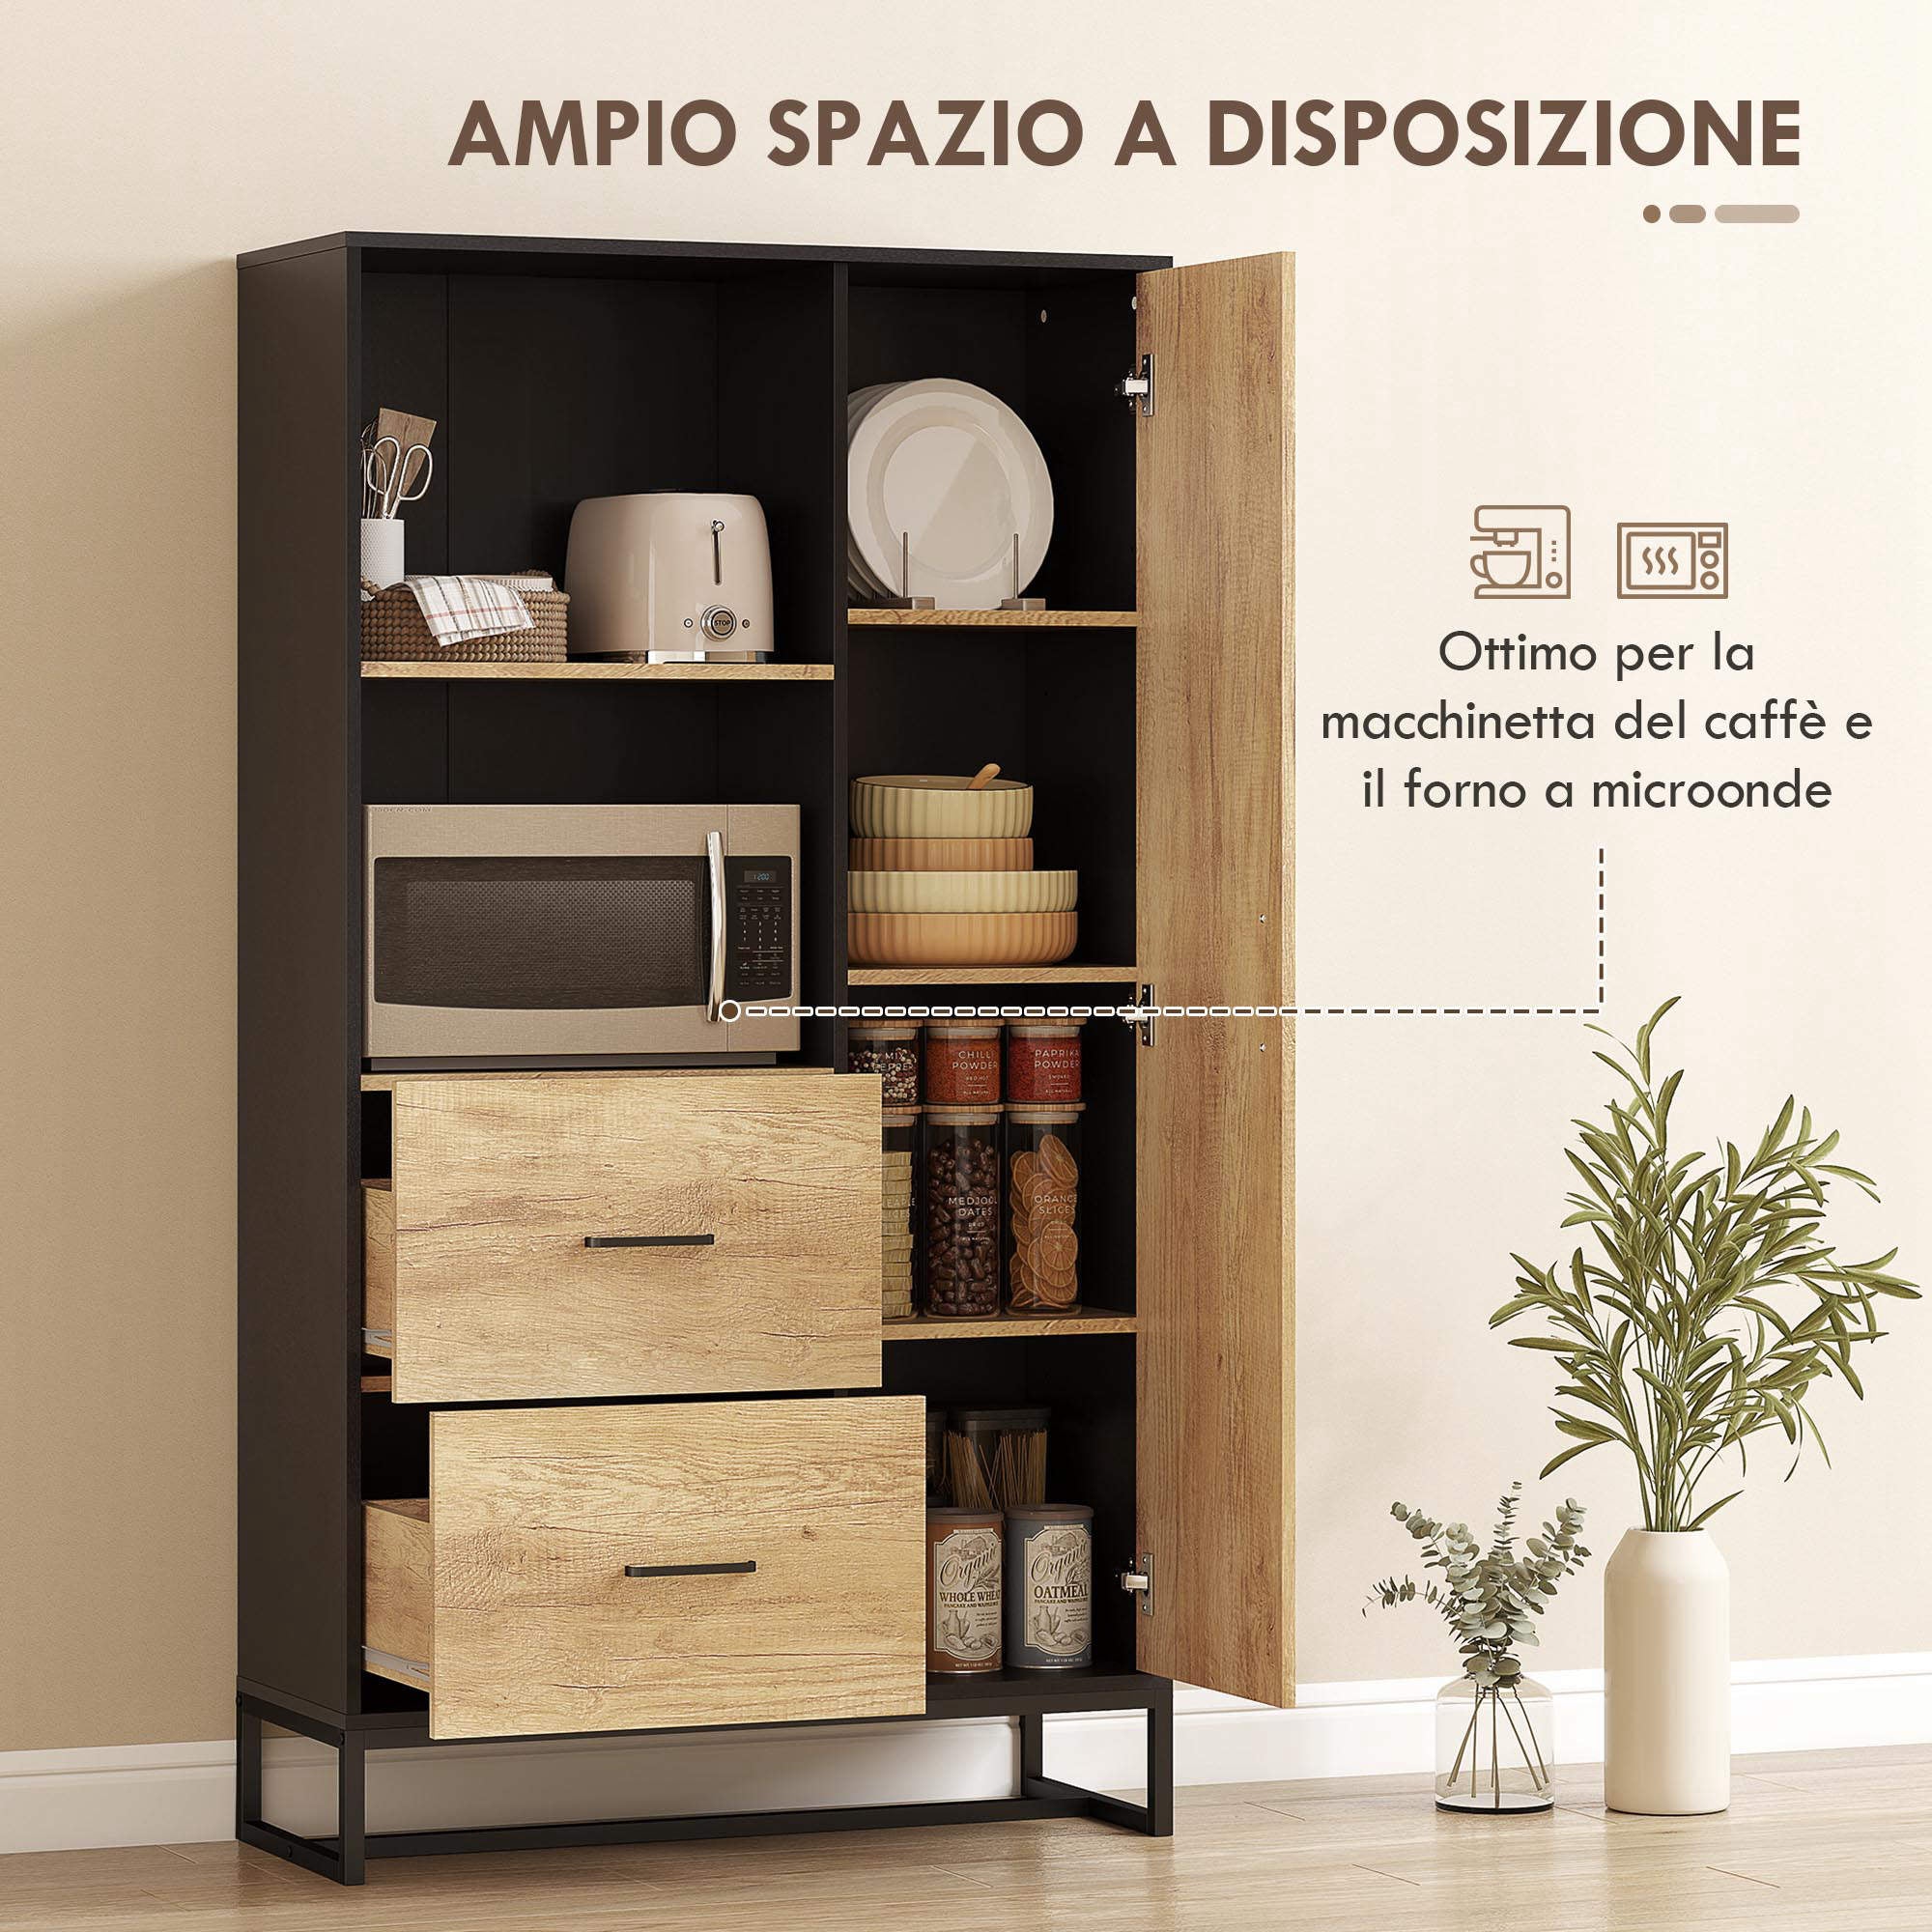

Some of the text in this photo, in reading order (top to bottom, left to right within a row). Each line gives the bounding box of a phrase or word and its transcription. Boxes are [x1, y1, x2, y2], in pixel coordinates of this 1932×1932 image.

[885, 1051, 904, 1060] MIX
[1035, 1049, 1080, 1058] PAPRIKA
[952, 1062, 998, 1070] POWDER
[1034, 1060, 1080, 1068] POWDER
[948, 1196, 998, 1206] MEDJOOL
[1034, 1194, 1077, 1204] ORANGE
[958, 1207, 993, 1216] DATES
[1038, 1205, 1075, 1214] SLICES
[1034, 1584, 1089, 1599] OATMEAL
[939, 1591, 976, 1603] WHOLE
